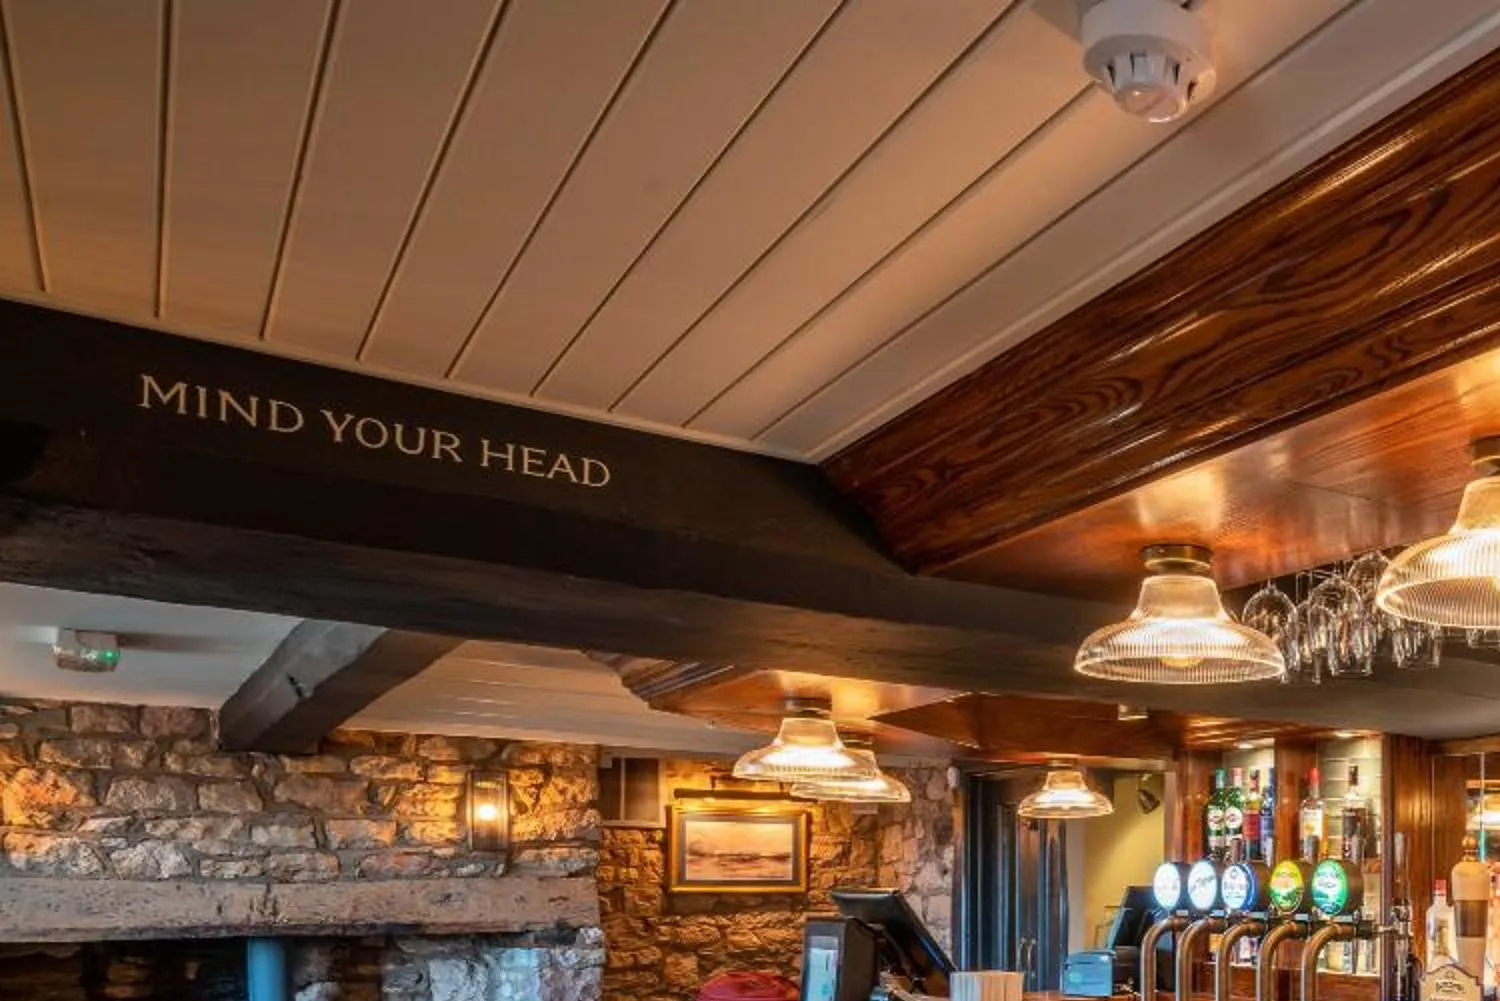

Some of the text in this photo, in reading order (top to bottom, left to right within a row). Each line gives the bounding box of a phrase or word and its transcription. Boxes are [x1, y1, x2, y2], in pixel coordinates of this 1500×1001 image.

[137, 374, 611, 487] MIND YOUR HEAD
